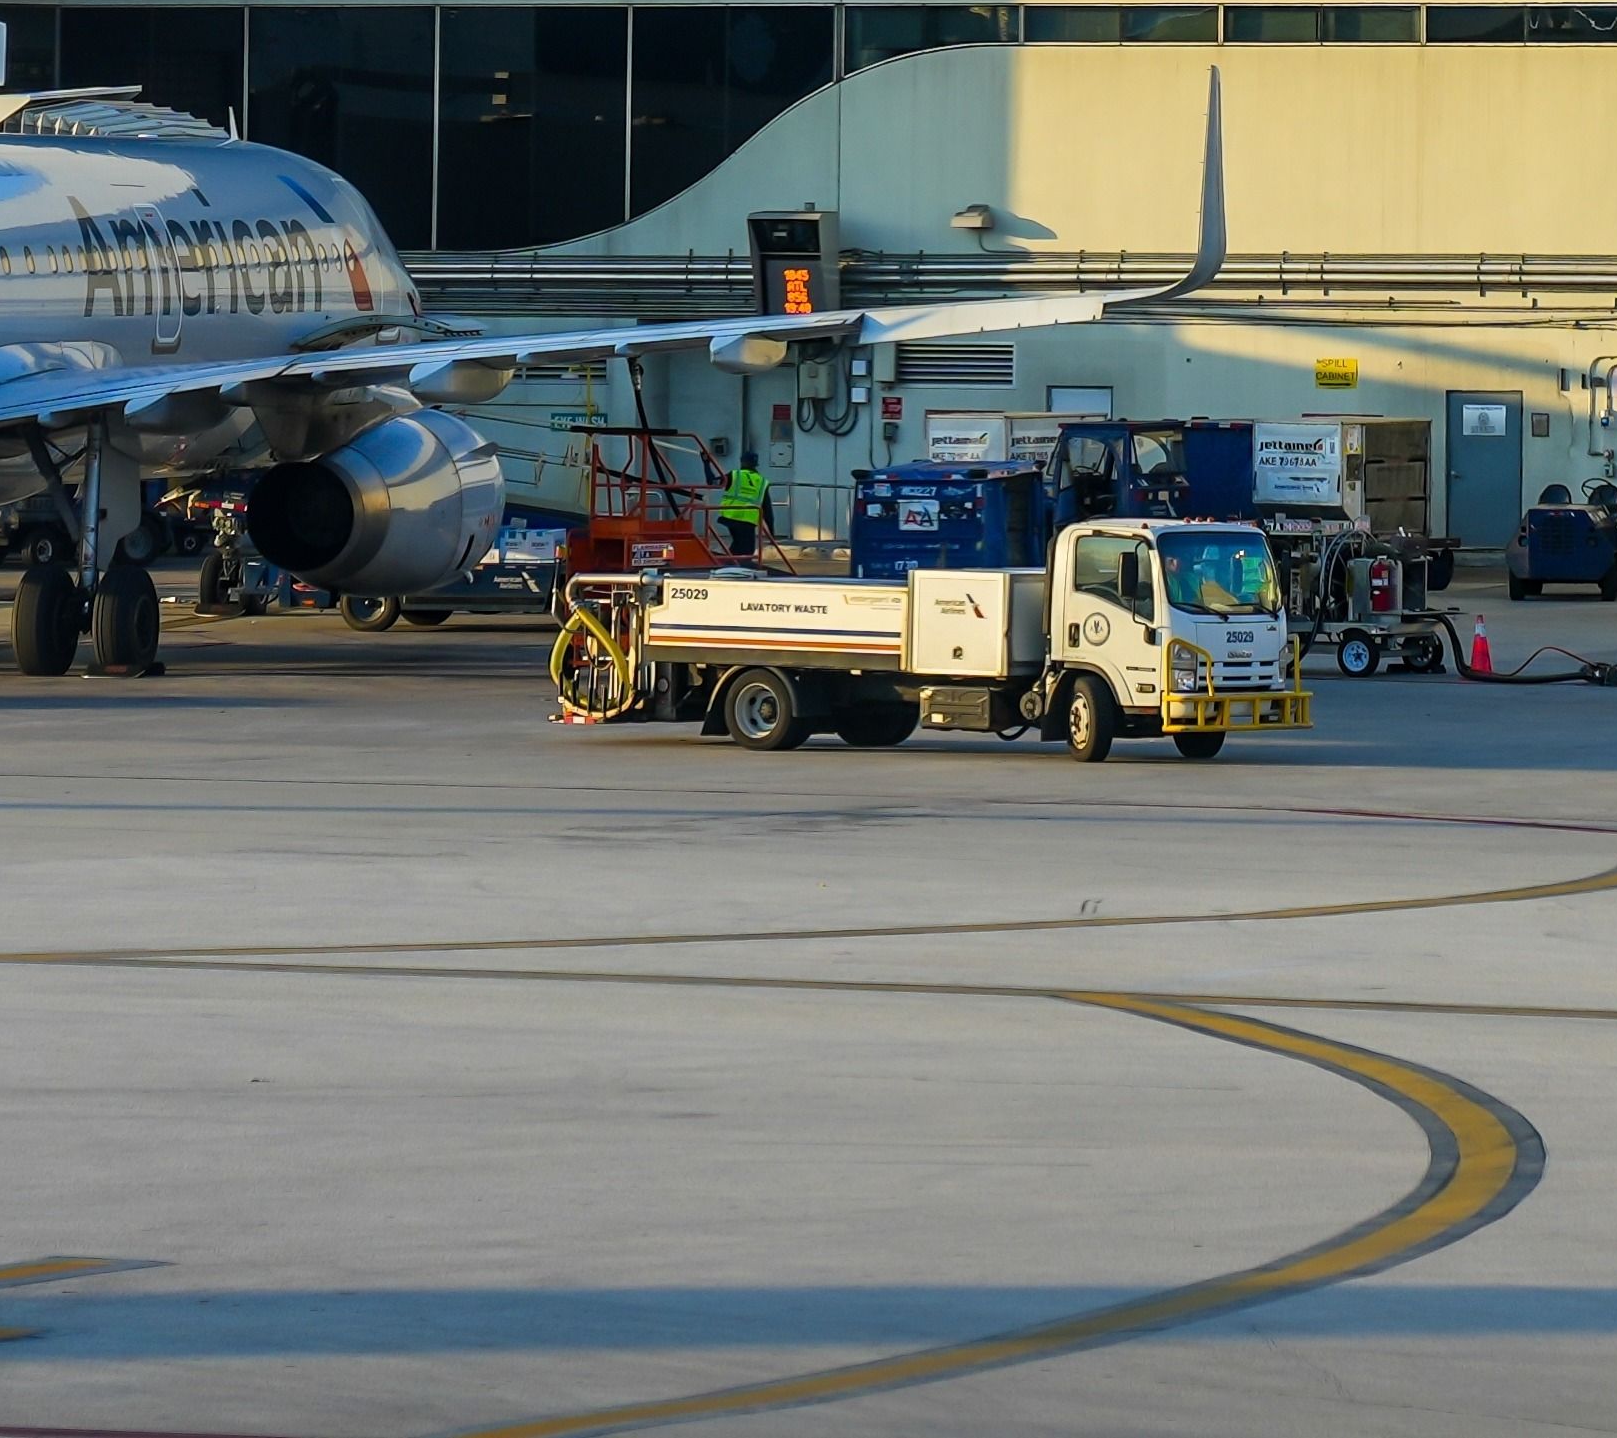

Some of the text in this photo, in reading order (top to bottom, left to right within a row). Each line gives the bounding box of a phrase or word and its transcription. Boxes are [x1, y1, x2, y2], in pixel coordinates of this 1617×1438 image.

[66, 188, 323, 318] American
[1320, 358, 1348, 368] SPILL
[1315, 371, 1356, 381] CABINET
[1258, 456, 1277, 466] AKE
[671, 587, 709, 601] 25029
[740, 602, 828, 615] LAVATORY WASTE
[1226, 630, 1254, 644] 25029
